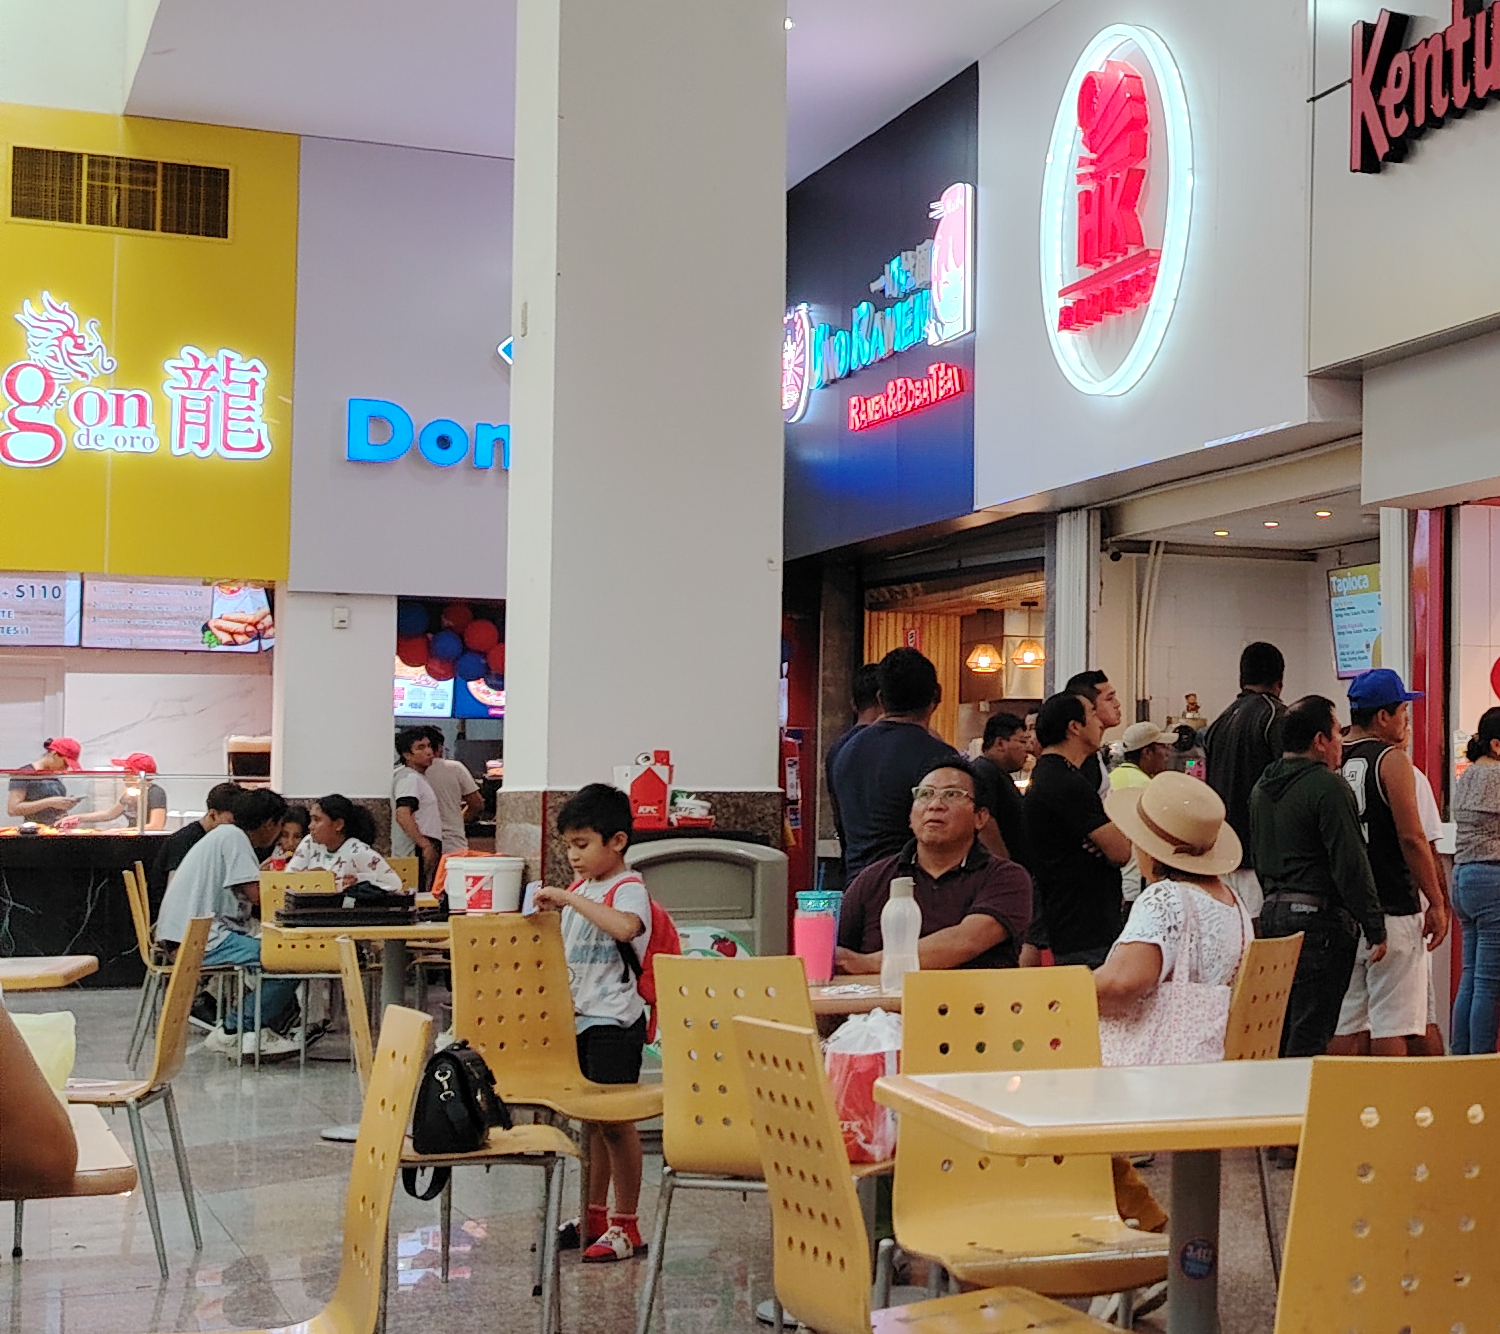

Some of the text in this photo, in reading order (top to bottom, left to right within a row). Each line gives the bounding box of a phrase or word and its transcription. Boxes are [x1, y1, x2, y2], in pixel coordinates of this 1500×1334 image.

[171, 351, 266, 453] 龍
[77, 428, 155, 450] de oro
[1330, 572, 1370, 594] Tapioca
